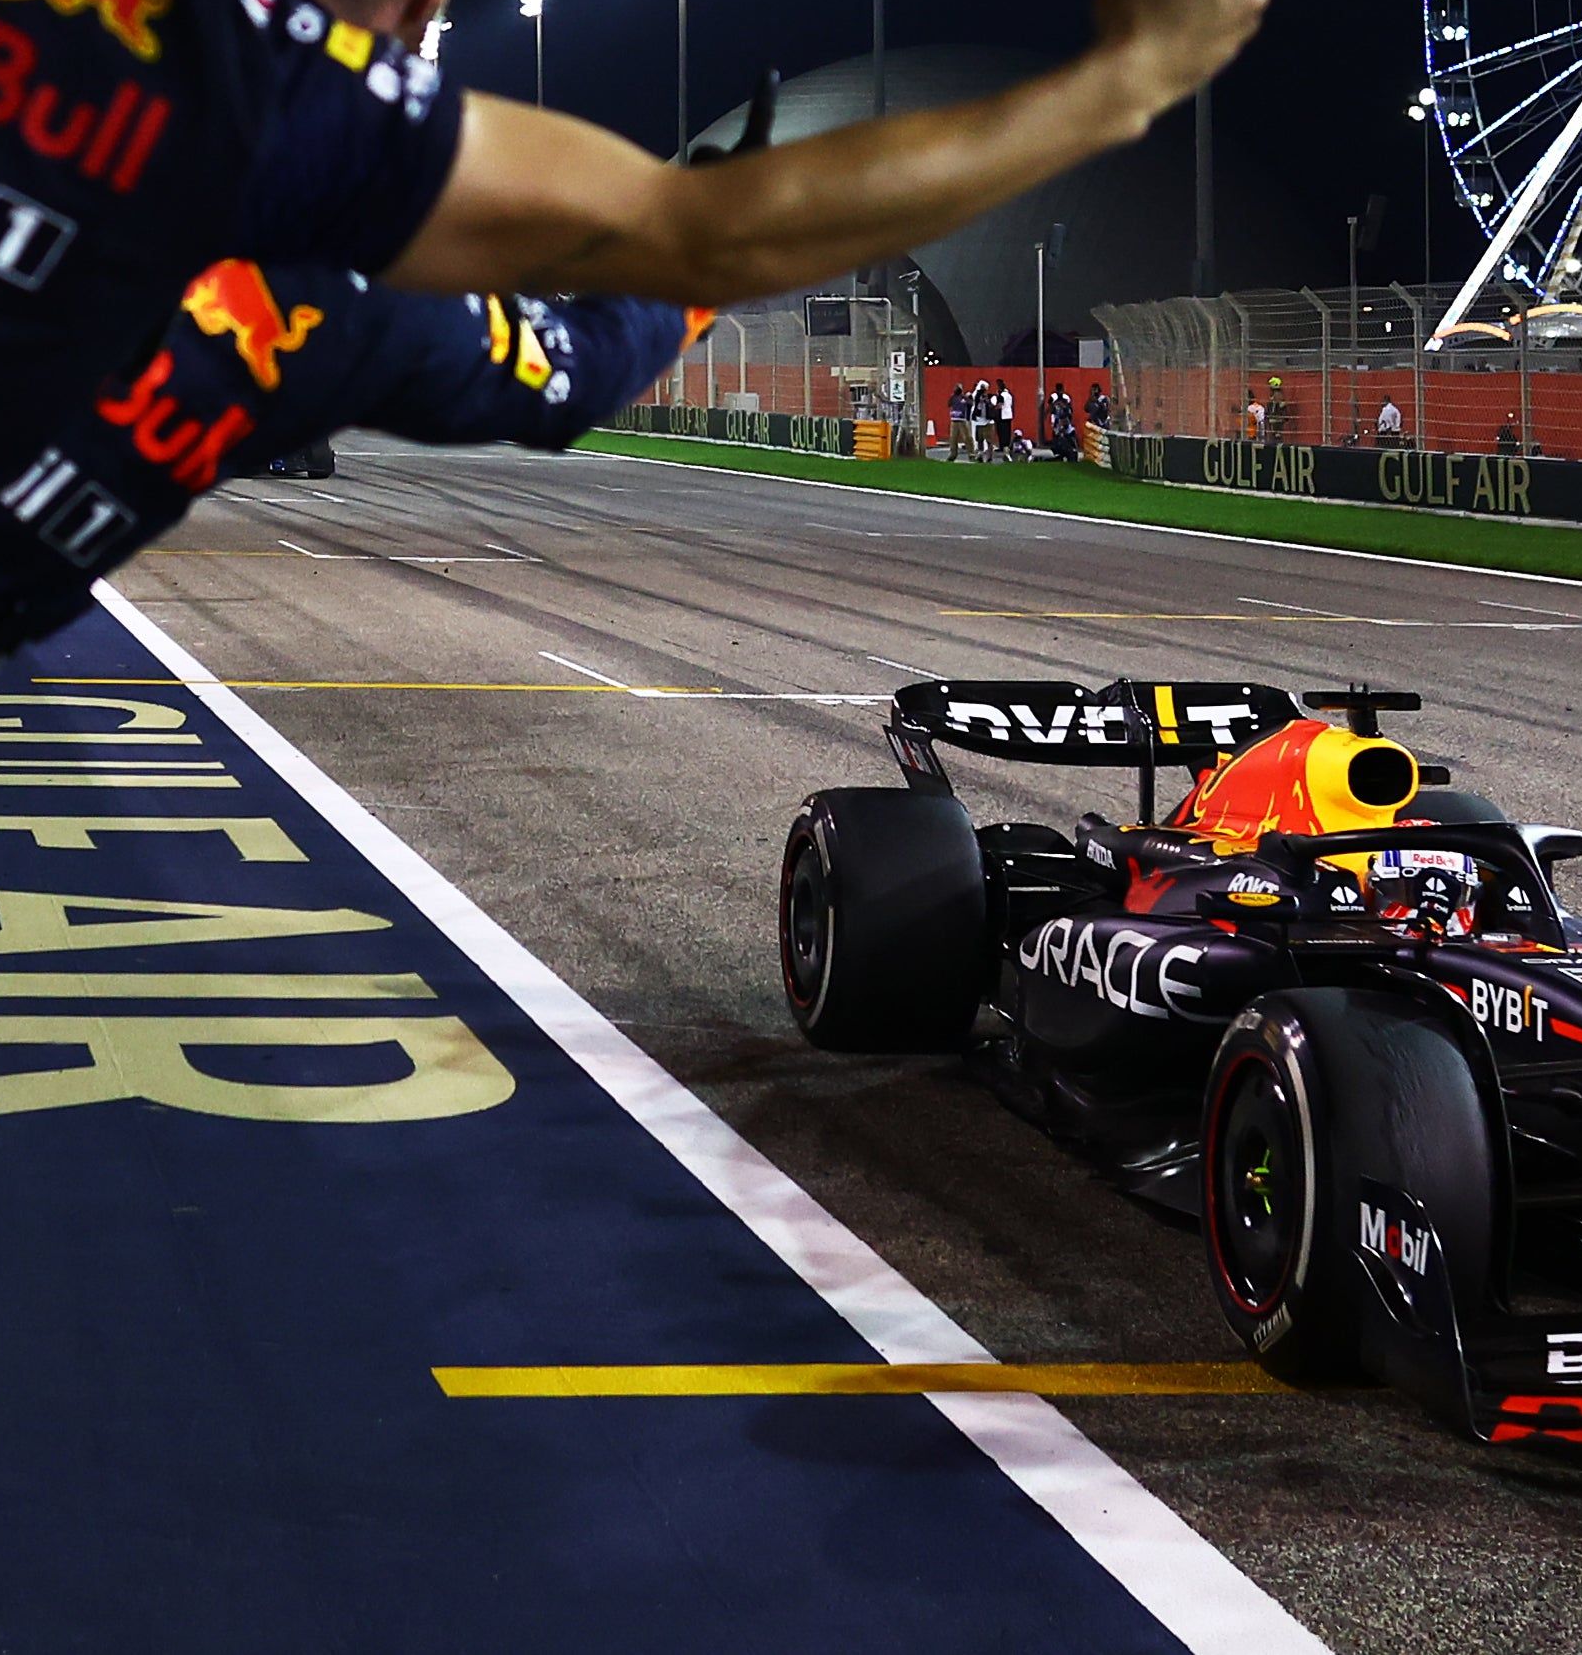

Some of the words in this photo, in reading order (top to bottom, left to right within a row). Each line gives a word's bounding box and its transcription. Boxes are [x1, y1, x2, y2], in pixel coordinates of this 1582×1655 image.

[726, 408, 752, 441] GULF
[753, 412, 770, 444] AIR
[789, 413, 820, 449] GULF
[821, 417, 841, 454] AIR
[1203, 438, 1265, 488] GULF
[1271, 443, 1316, 495] AIR
[1378, 451, 1466, 506] GULF
[1472, 455, 1533, 514] AIR
[1472, 977, 1548, 1042] BYBIT
[1360, 1201, 1430, 1276] Mobil
